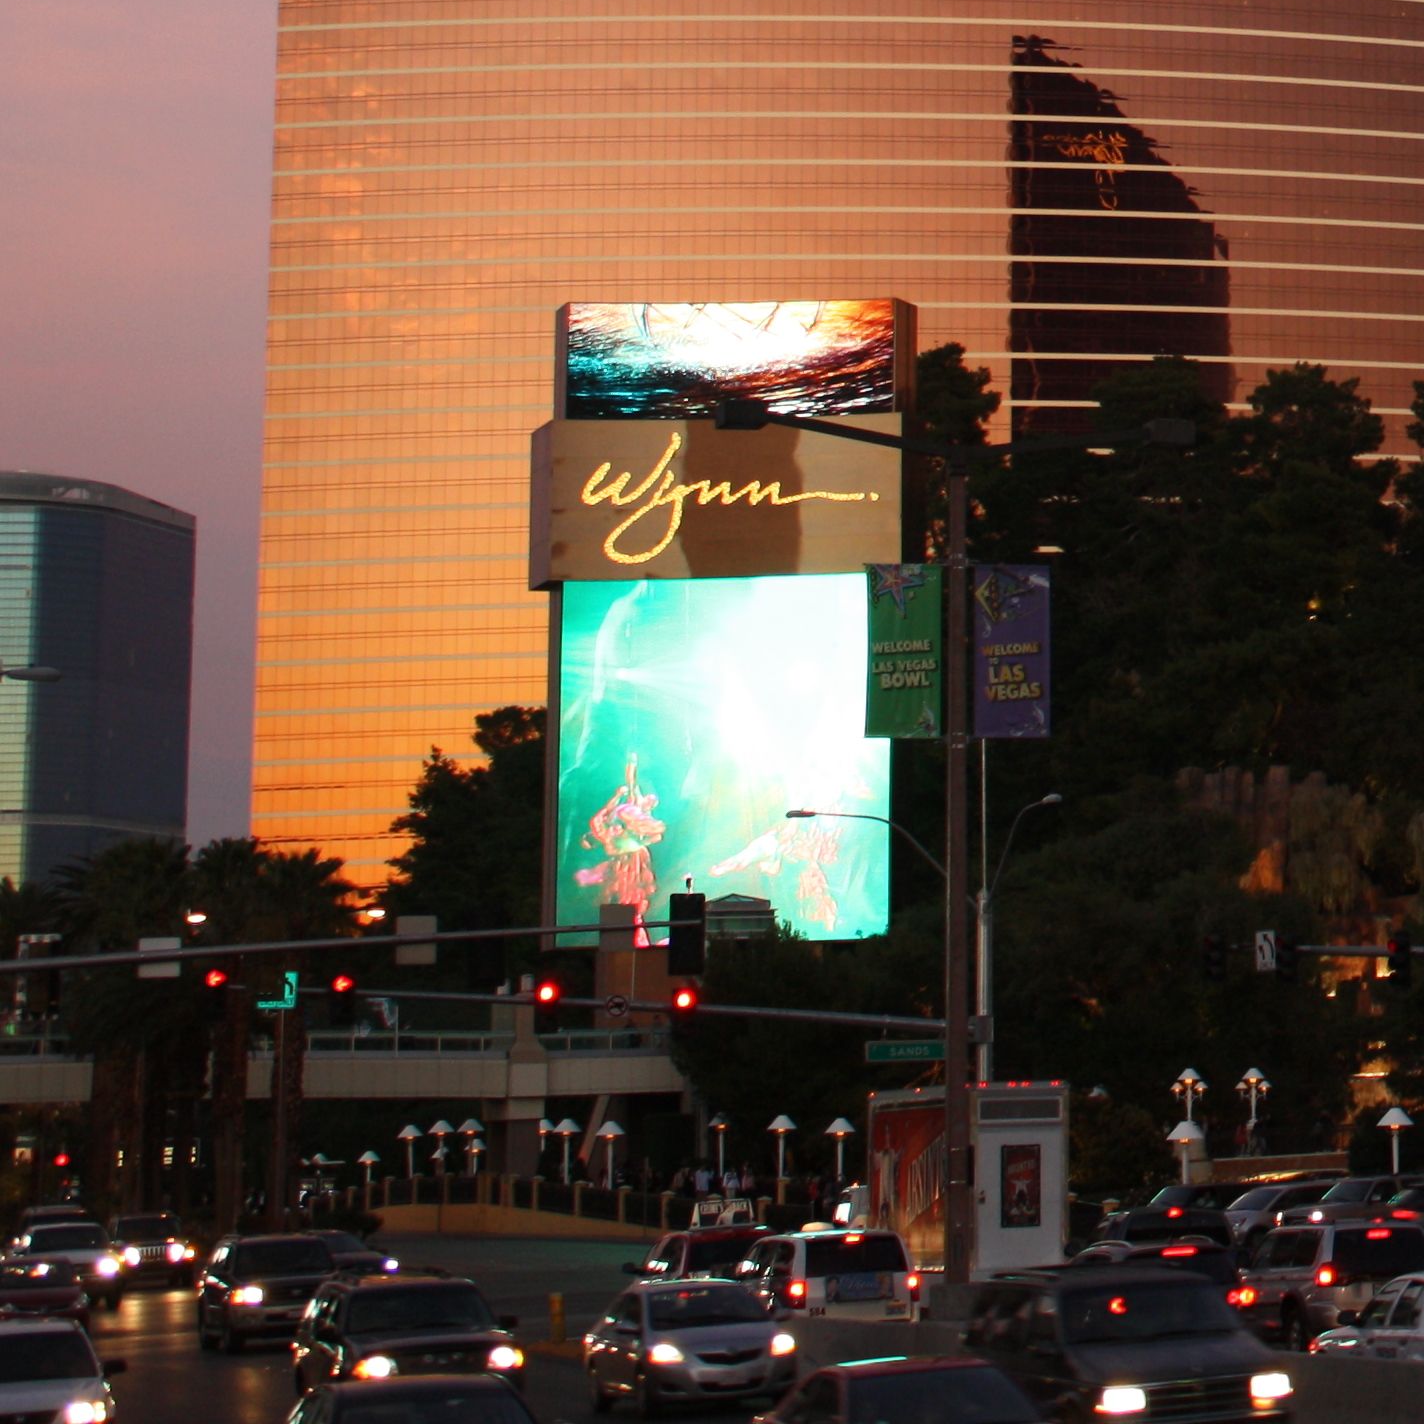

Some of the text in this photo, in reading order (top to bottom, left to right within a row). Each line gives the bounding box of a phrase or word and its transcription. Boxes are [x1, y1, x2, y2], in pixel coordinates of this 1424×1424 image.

[873, 640, 931, 654] WELCOME
[982, 642, 1040, 656] WELCOME
[872, 658, 937, 673] LAS VEGAS
[880, 672, 930, 689] BOWL
[988, 664, 1025, 684] LAS
[985, 682, 1042, 701] VEGAS
[889, 1047, 930, 1057] SANDS
